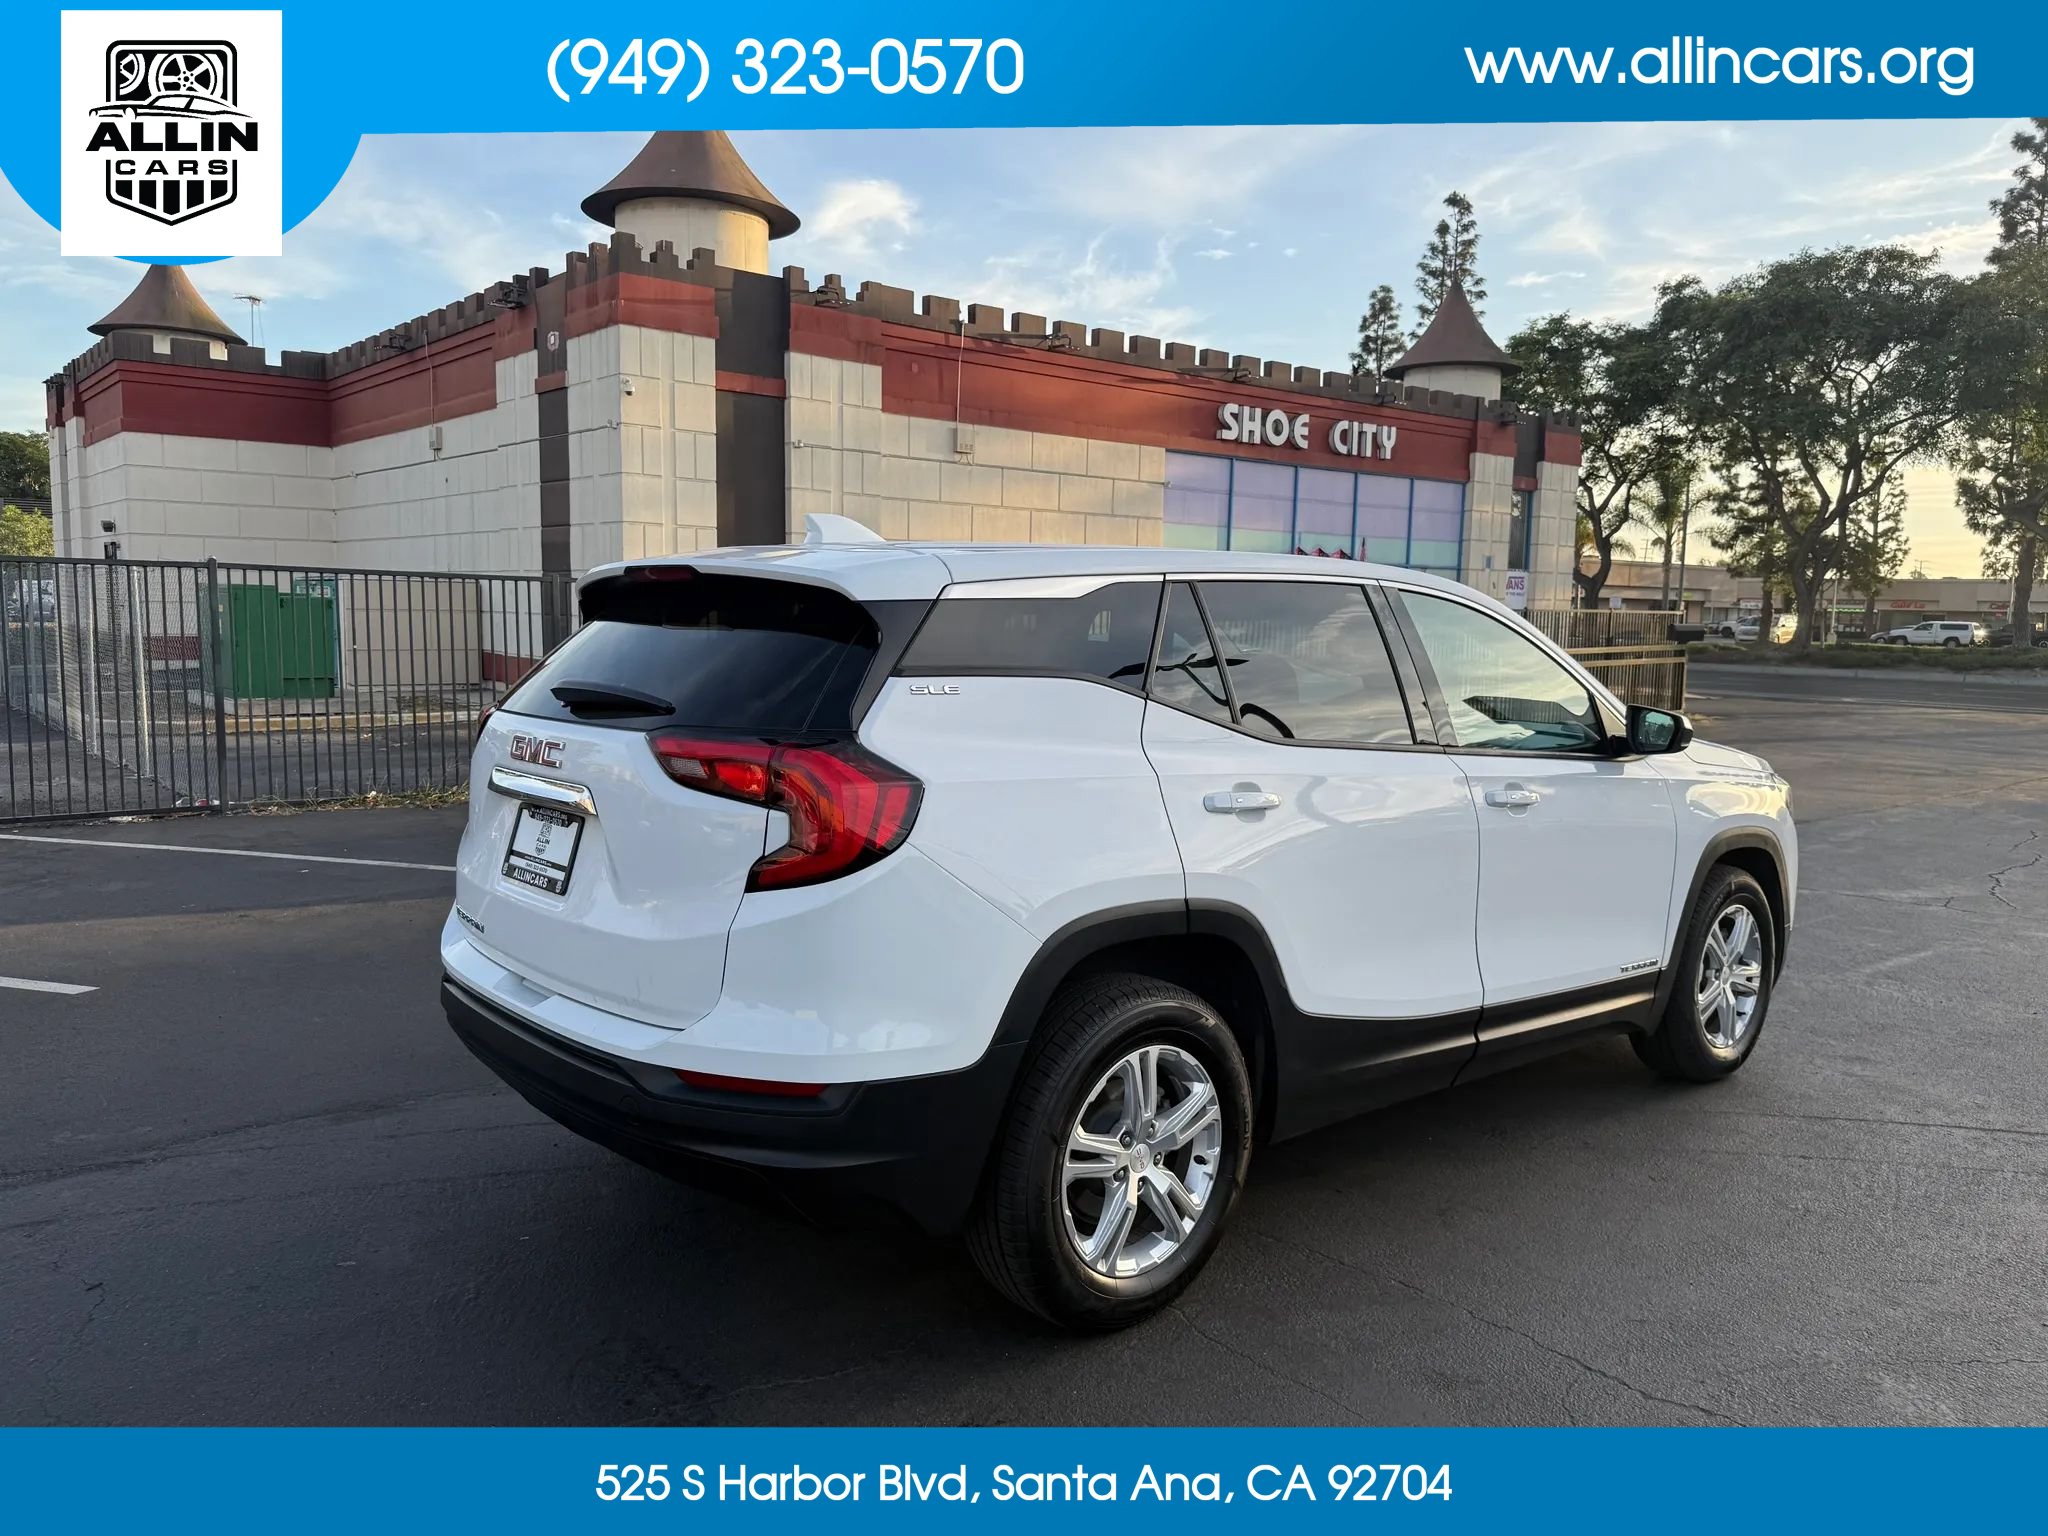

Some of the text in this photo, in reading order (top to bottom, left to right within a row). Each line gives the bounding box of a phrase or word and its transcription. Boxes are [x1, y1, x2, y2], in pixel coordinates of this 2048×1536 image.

[1216, 403, 1397, 460] SHOE CITY
[909, 684, 960, 695] SLE
[511, 734, 566, 769] GMC
[512, 867, 549, 888] ALLINCARS
